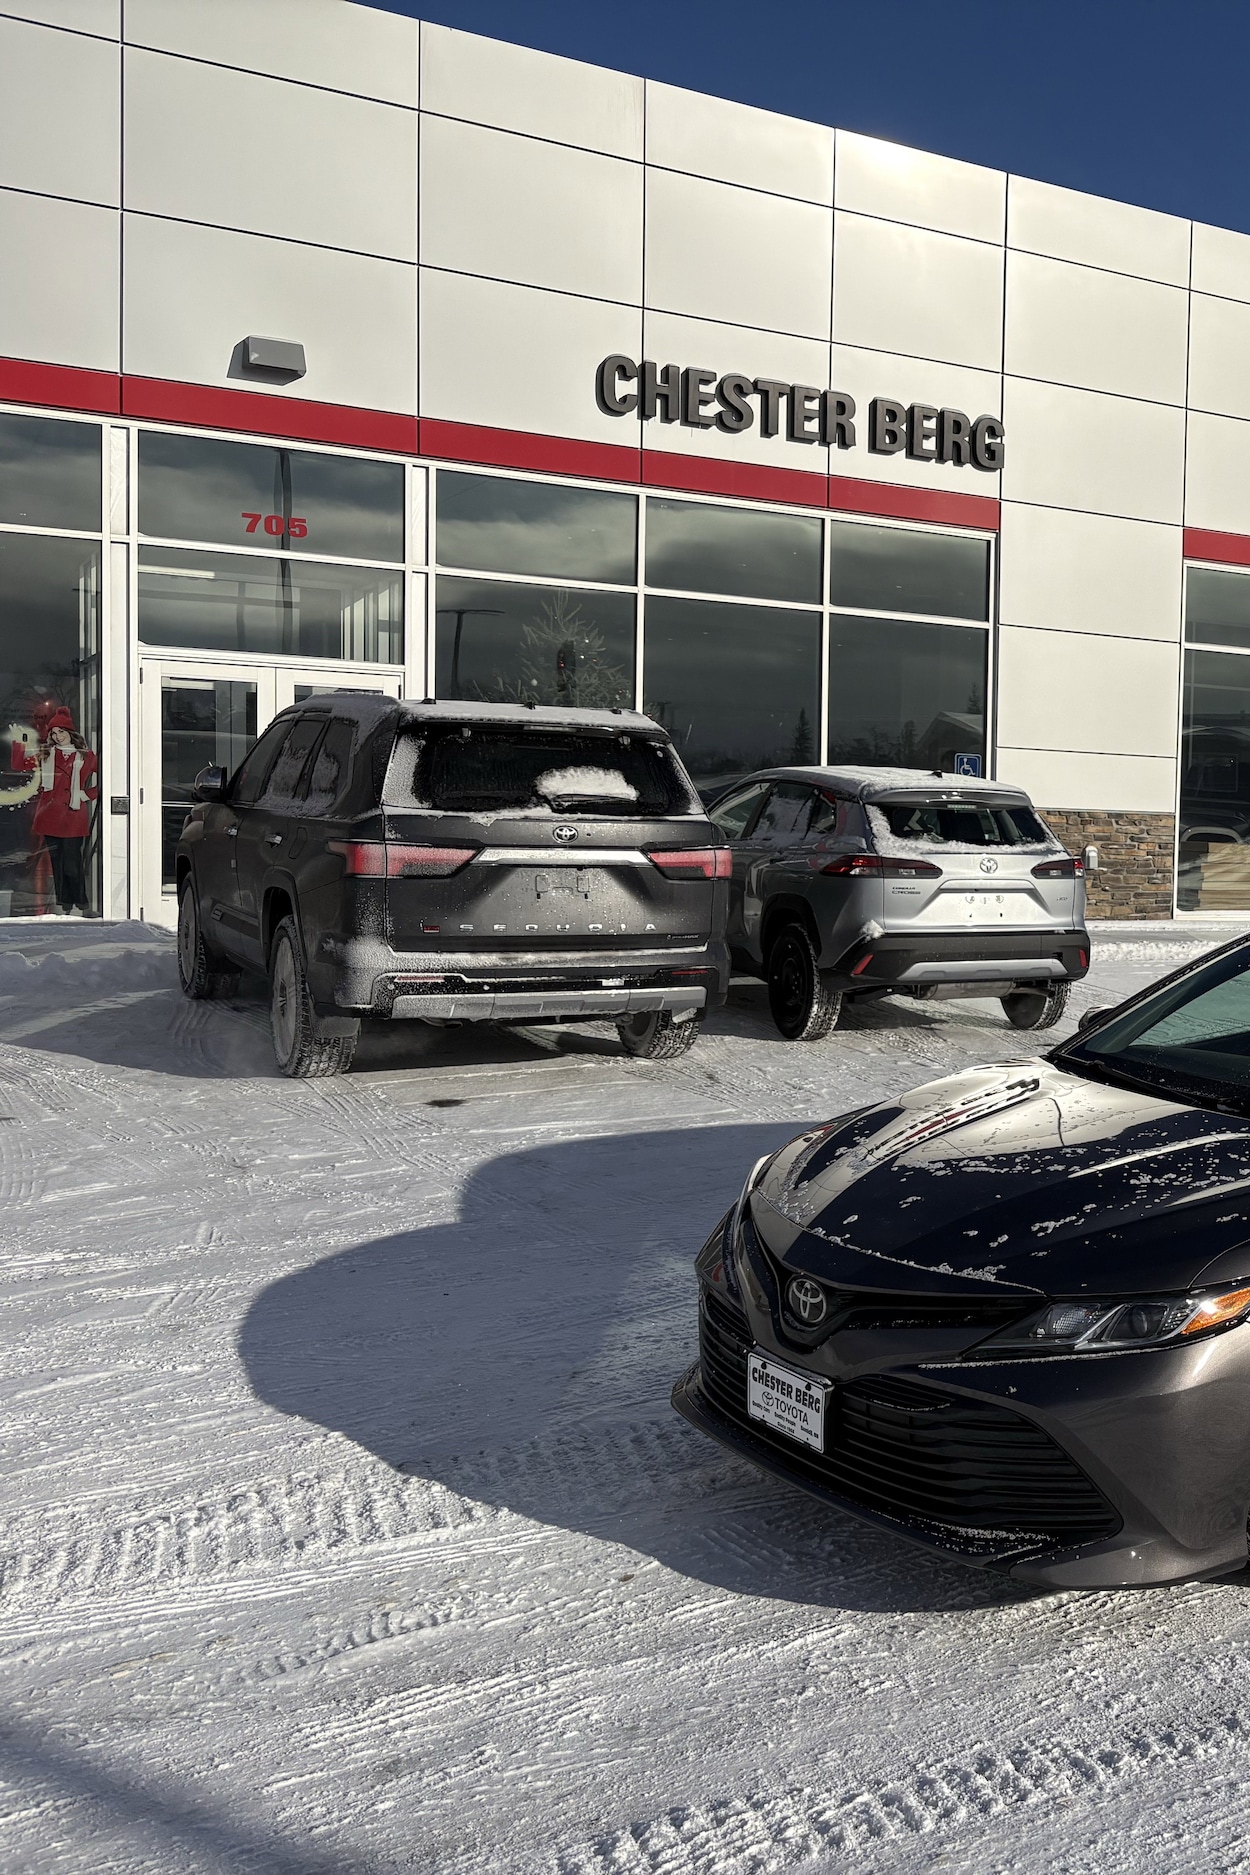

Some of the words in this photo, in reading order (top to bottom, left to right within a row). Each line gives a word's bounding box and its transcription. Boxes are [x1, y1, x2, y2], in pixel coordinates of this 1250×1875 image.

[595, 353, 857, 449] CHESTER
[868, 397, 1005, 472] BERG
[241, 512, 308, 538] 705
[459, 923, 657, 932] SEQUOIA
[751, 1366, 793, 1400] CHESTER
[795, 1387, 821, 1414] BERG
[774, 1397, 809, 1425] TOYOTA
